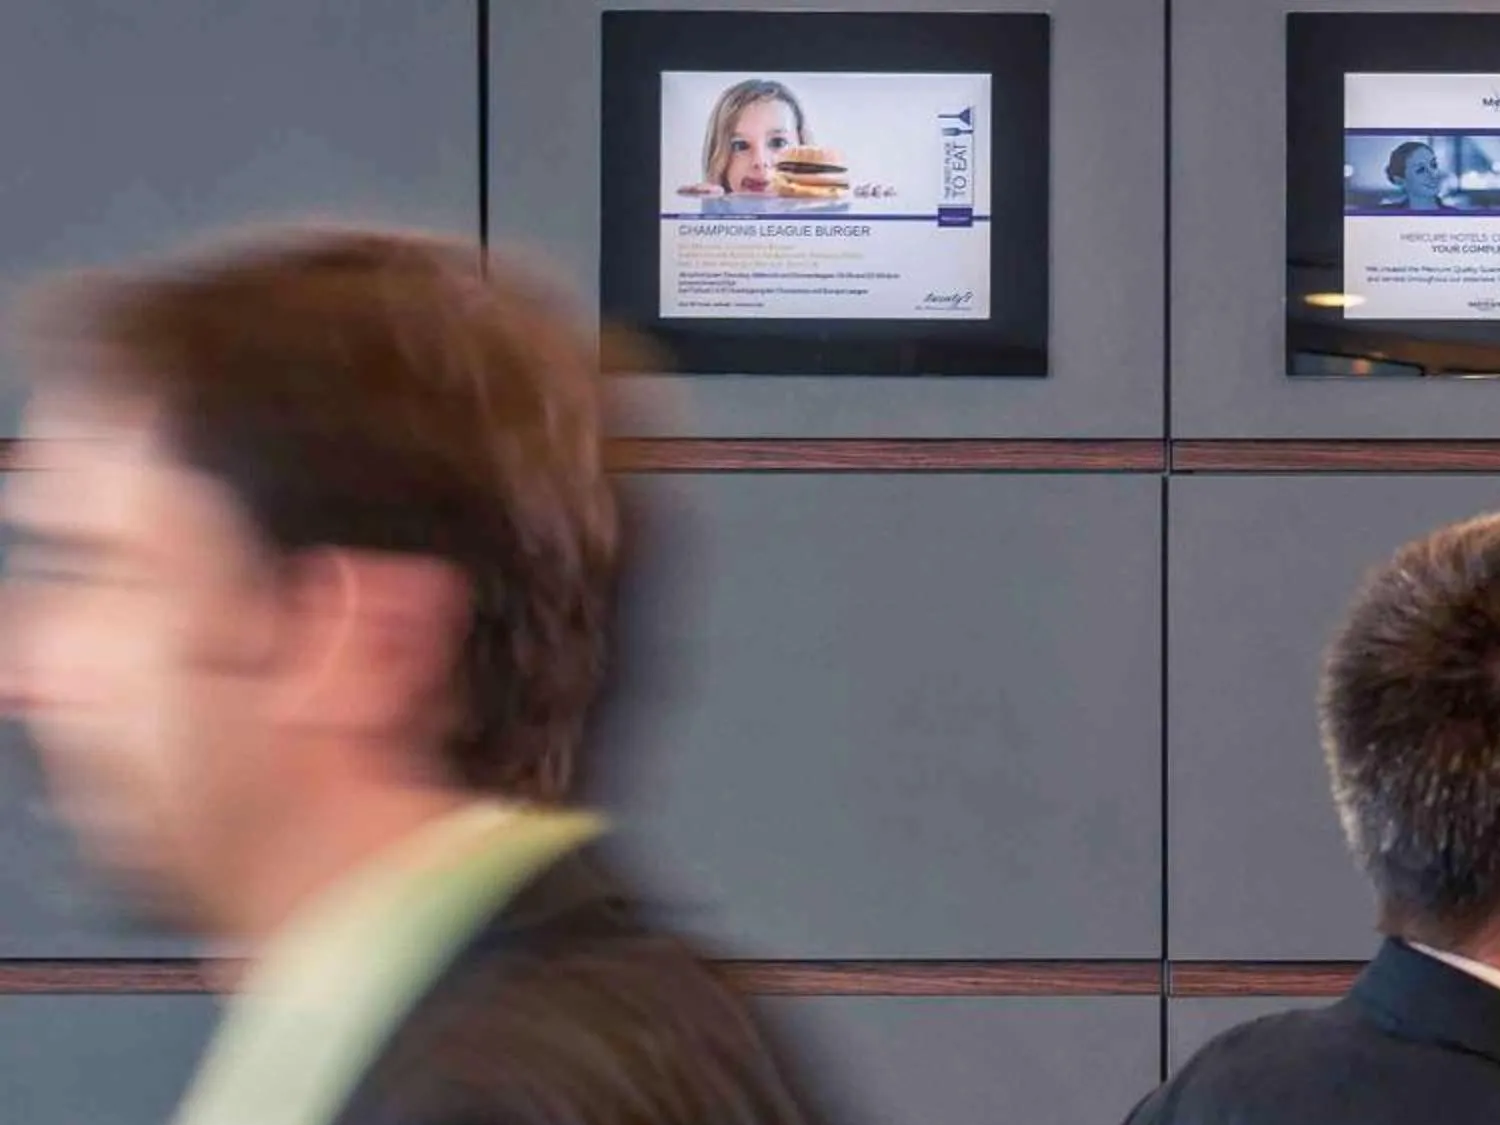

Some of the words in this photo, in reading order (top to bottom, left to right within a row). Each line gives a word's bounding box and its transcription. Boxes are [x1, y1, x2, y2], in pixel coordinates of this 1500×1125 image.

[953, 142, 967, 171] EAT
[953, 175, 967, 198] TO
[678, 225, 757, 236] CHAMPIONS
[760, 225, 812, 236] LEAGUE
[815, 225, 872, 237] BURGER
[1432, 245, 1461, 254] YOUR
